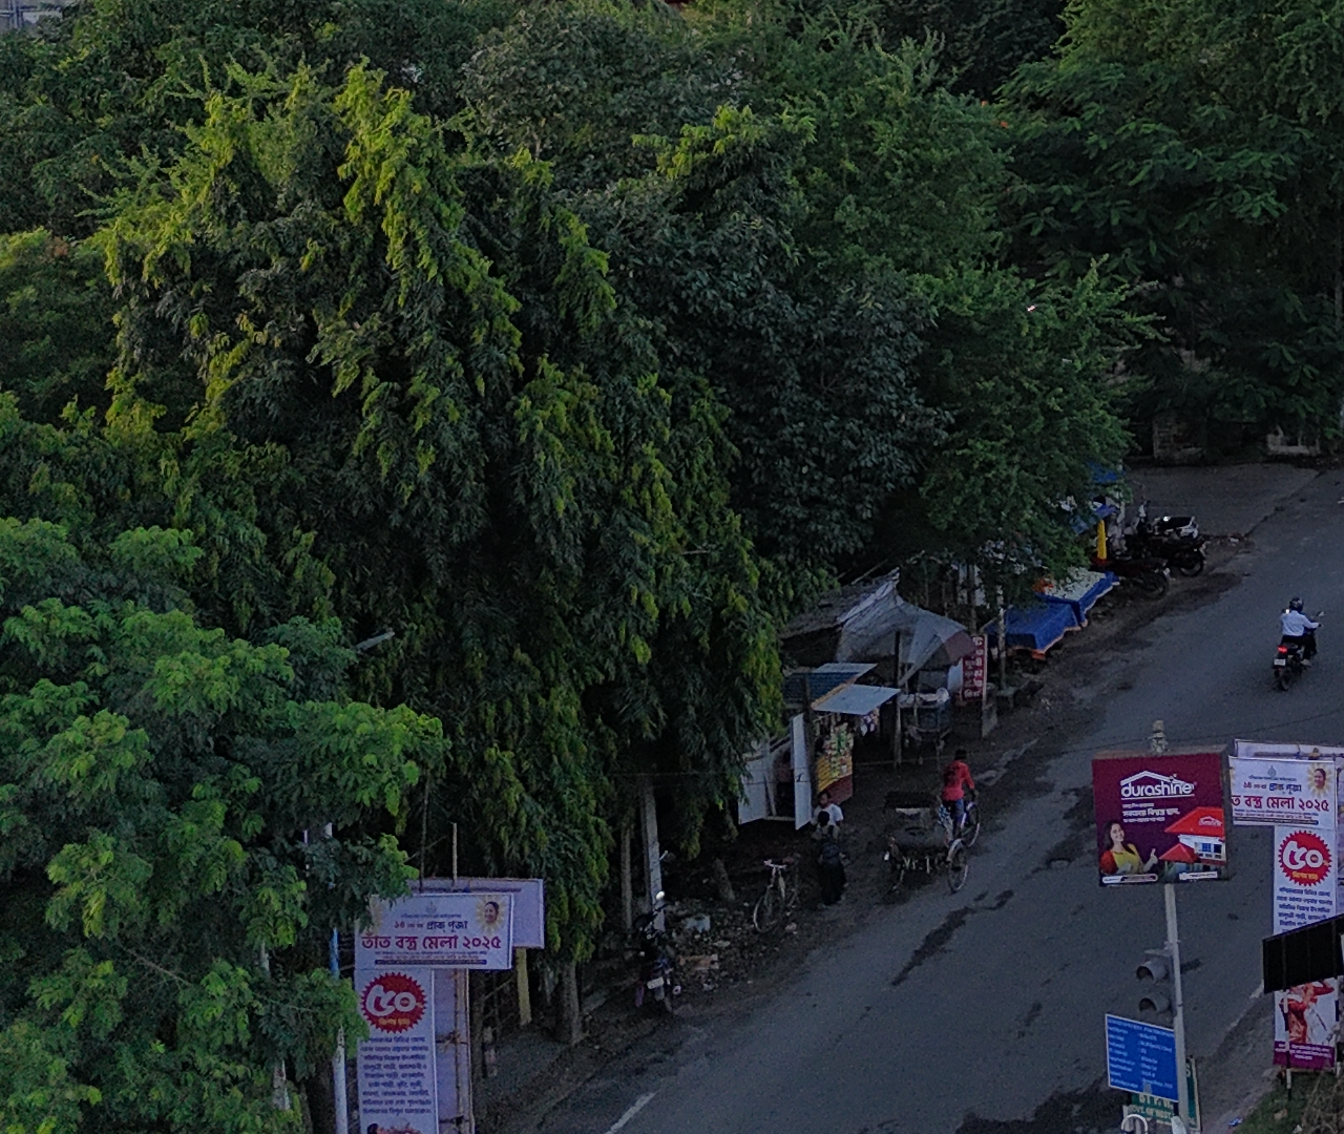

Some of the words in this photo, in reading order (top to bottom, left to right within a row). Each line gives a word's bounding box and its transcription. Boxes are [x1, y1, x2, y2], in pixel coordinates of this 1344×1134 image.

[1121, 780, 1195, 797] durashine
[1266, 796, 1295, 809] মেলা
[1298, 798, 1330, 812] ২০২৫
[361, 931, 391, 949] তাঁত
[395, 935, 419, 950] বস্ত্র
[422, 935, 459, 950] মেলা
[462, 935, 502, 950] ২০২৫
